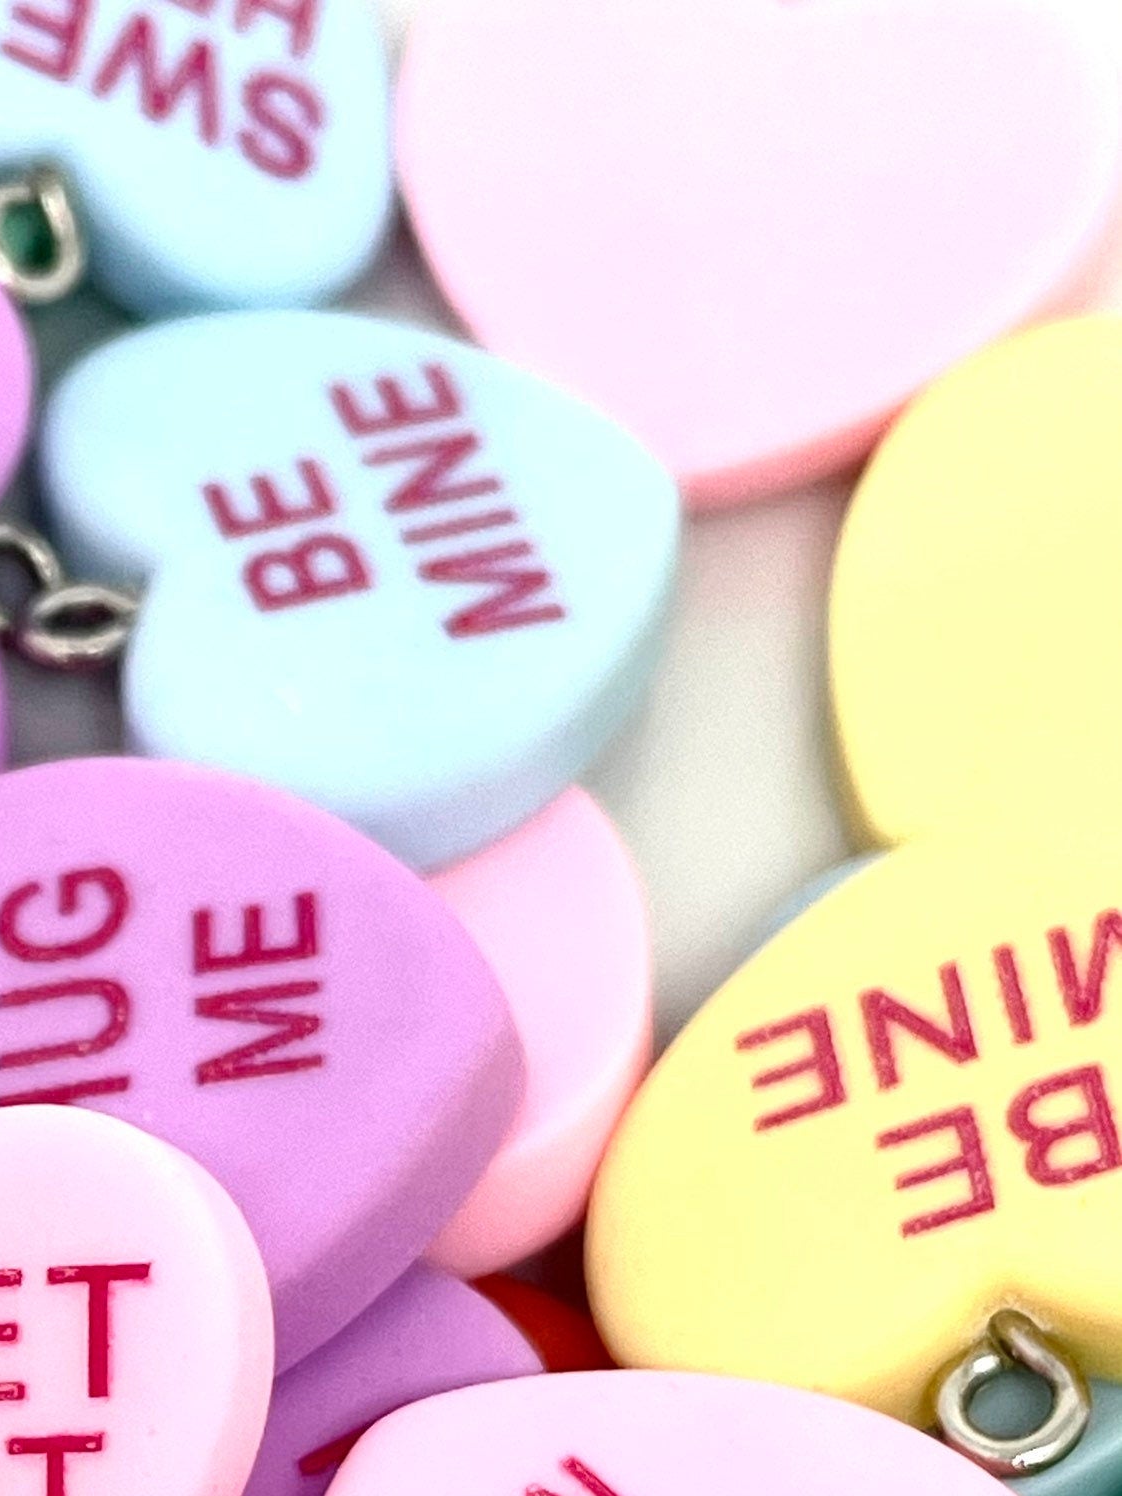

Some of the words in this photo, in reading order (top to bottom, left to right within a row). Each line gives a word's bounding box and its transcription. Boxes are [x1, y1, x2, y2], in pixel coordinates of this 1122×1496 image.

[203, 459, 372, 612] BE
[328, 362, 566, 640] MINE
[192, 891, 323, 1085] ME
[875, 1063, 1122, 1239] BE
